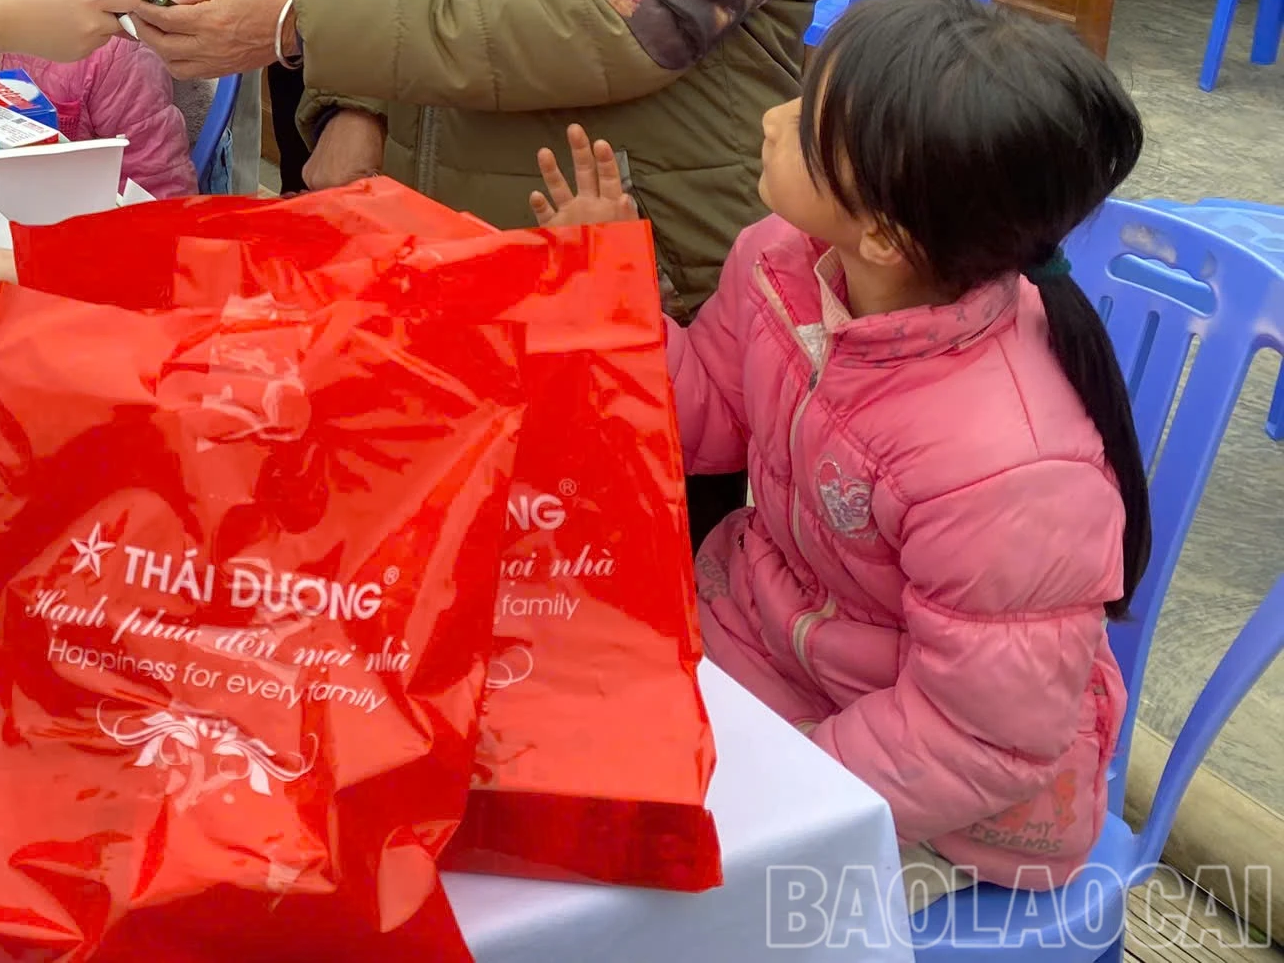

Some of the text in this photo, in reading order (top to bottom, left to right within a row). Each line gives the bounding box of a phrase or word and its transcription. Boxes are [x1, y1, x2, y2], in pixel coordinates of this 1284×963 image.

[123, 544, 215, 602] THÁI
[546, 543, 616, 577] nhà
[25, 588, 412, 674] Hạnh phúc đến mọi nhà
[501, 593, 581, 621] family
[47, 638, 388, 714] Happiness for every family
